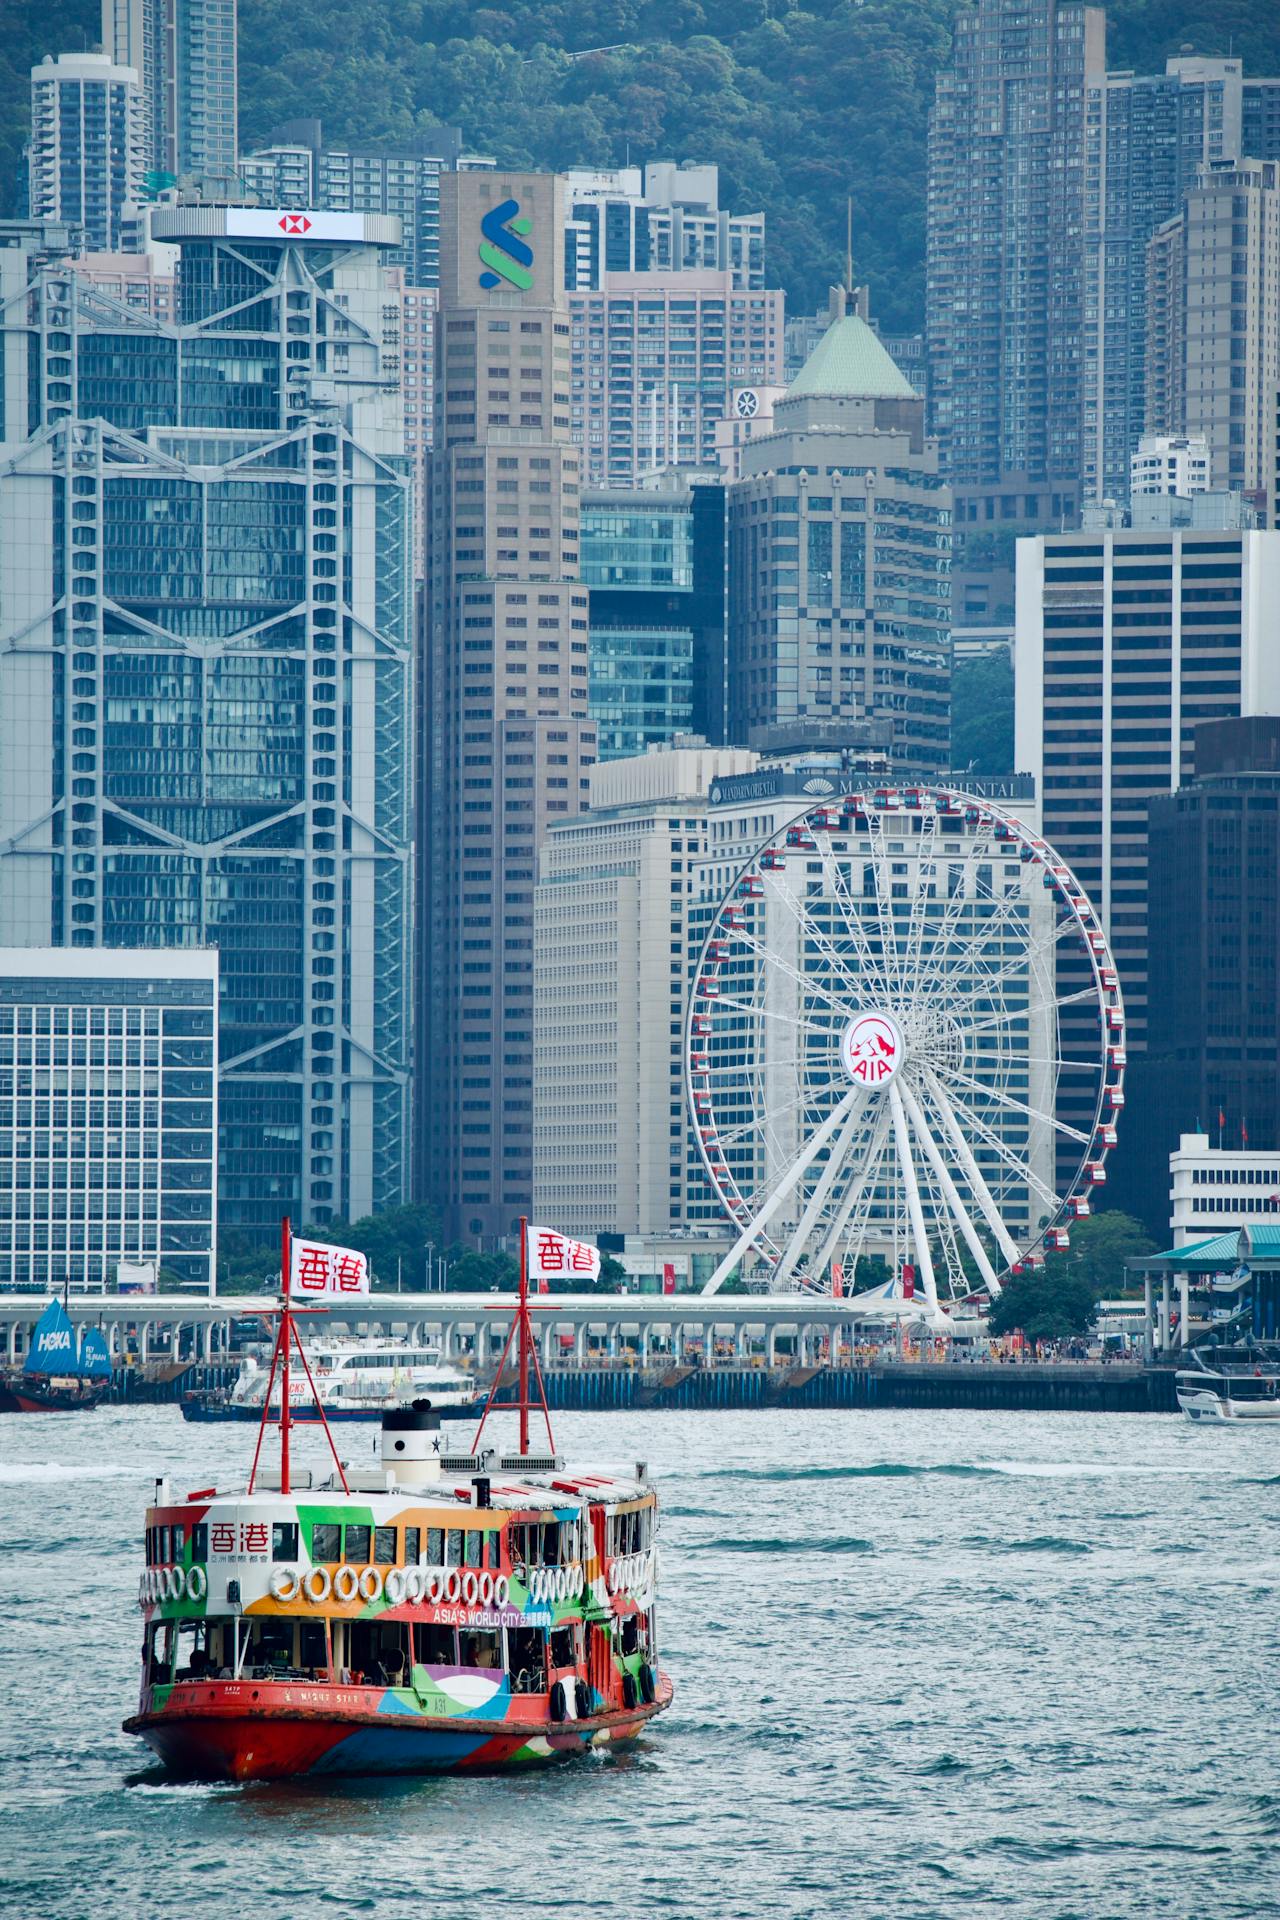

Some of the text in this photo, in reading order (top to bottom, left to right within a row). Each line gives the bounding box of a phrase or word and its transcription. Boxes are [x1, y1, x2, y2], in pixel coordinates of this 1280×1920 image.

[721, 780, 776, 801] MANDARIN ORIENTAL
[935, 781, 1017, 797] ORIENTAL
[852, 1059, 893, 1081] AIA
[537, 1233, 595, 1272] 香港
[299, 1248, 363, 1292] 香港
[37, 1330, 72, 1352] HOKA
[211, 1523, 269, 1552] 香港
[433, 1608, 466, 1624] ASIA'S
[467, 1610, 501, 1626] WORLD
[500, 1612, 520, 1627] CITY
[434, 1697, 447, 1713] A31
